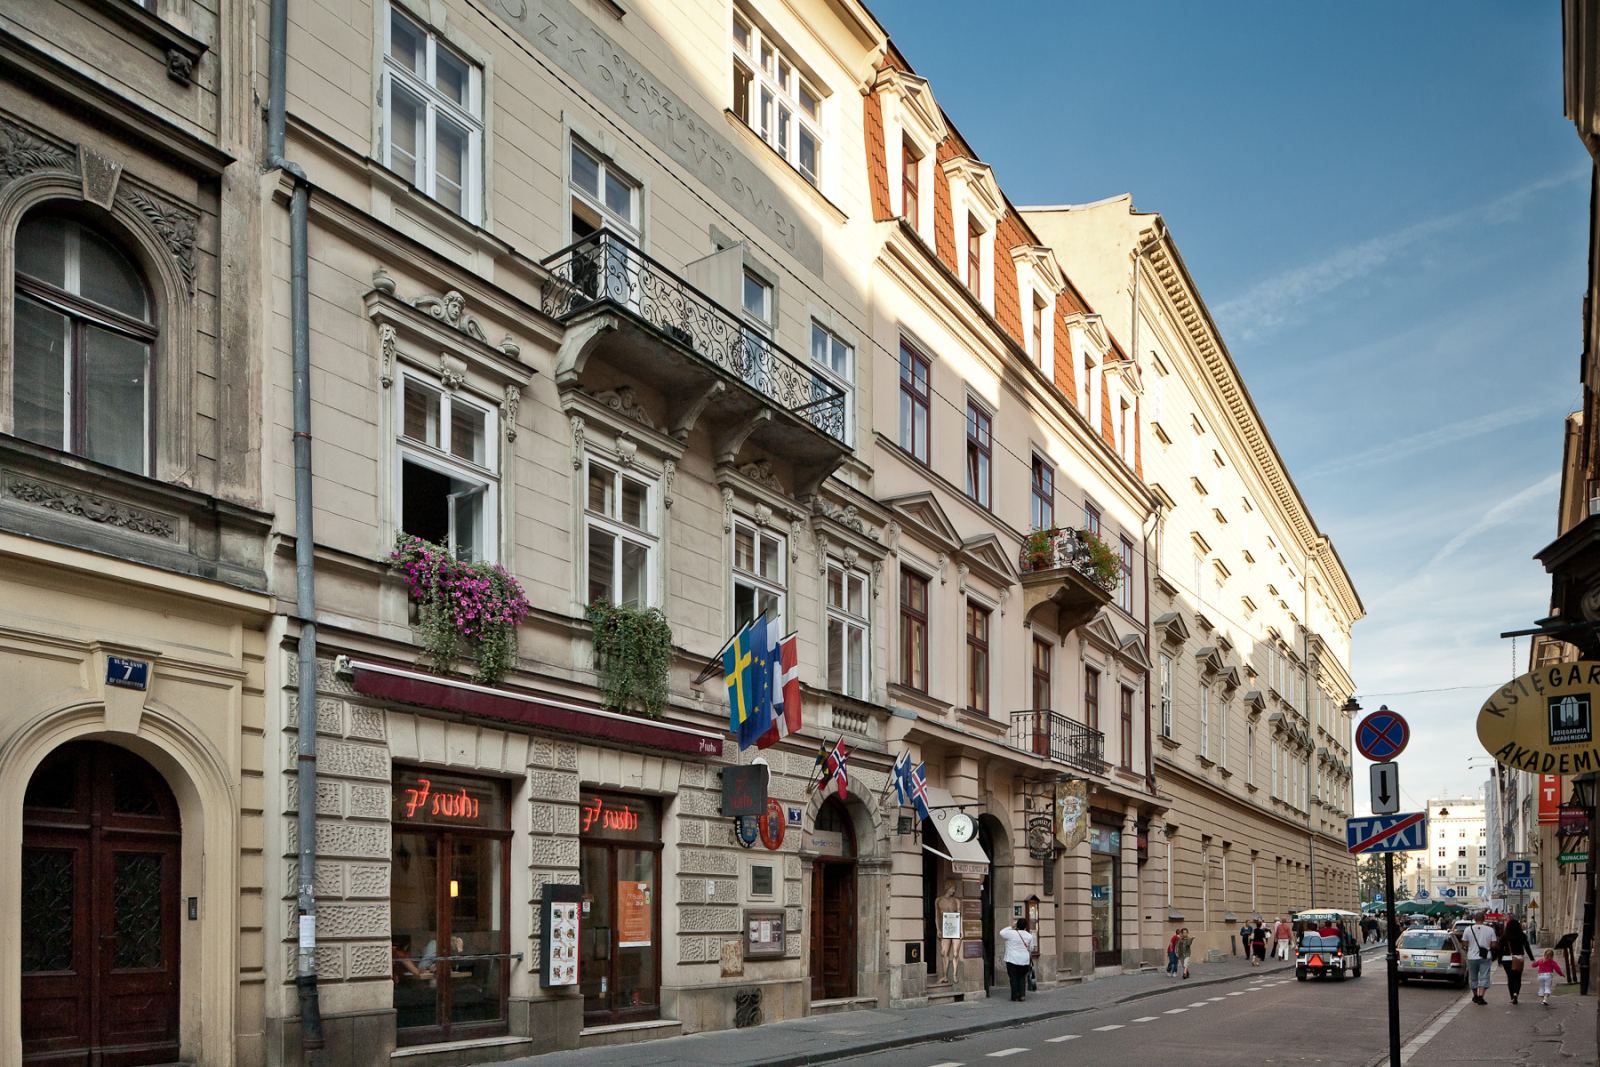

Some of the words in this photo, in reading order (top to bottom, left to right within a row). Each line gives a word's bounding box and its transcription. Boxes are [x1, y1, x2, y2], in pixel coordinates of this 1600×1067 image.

[123, 665, 133, 680] 7
[431, 787, 480, 819] sushi
[602, 806, 638, 831] sushi
[1349, 819, 1422, 849] TAXI
[1512, 862, 1526, 879] P
[1509, 878, 1533, 889] TAXI
